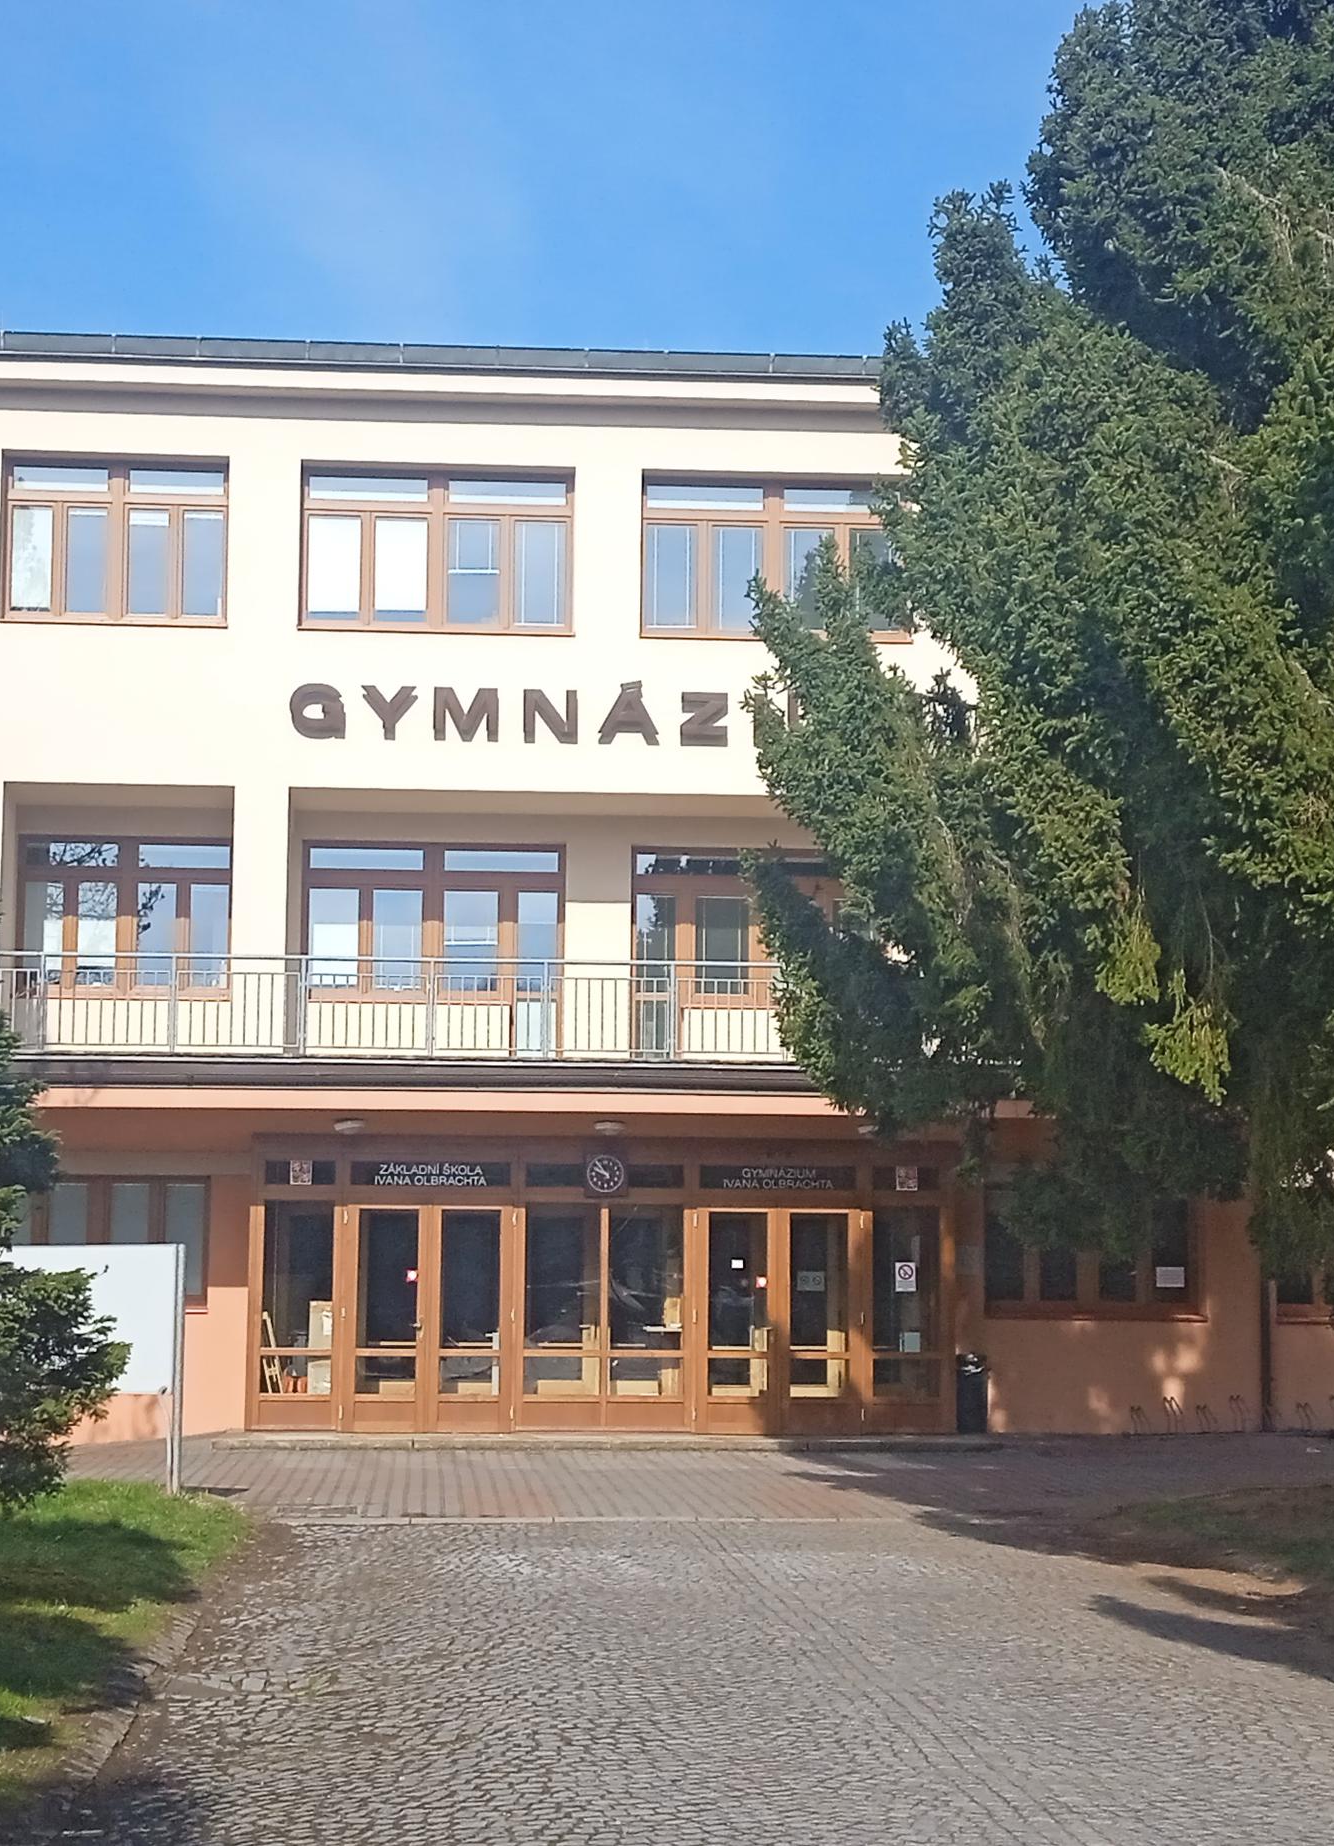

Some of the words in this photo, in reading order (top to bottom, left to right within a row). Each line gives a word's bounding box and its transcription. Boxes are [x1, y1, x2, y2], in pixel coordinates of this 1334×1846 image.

[378, 1162, 440, 1175] ZÁKLADNÍ
[442, 1162, 483, 1176] ŠKOLA
[741, 1165, 817, 1179] GYMNÁZIUM
[374, 1175, 412, 1186] IVANA
[414, 1175, 487, 1187] OLBRACHTA
[723, 1179, 760, 1189] IVANA
[762, 1179, 834, 1190] OLBRACHTA
